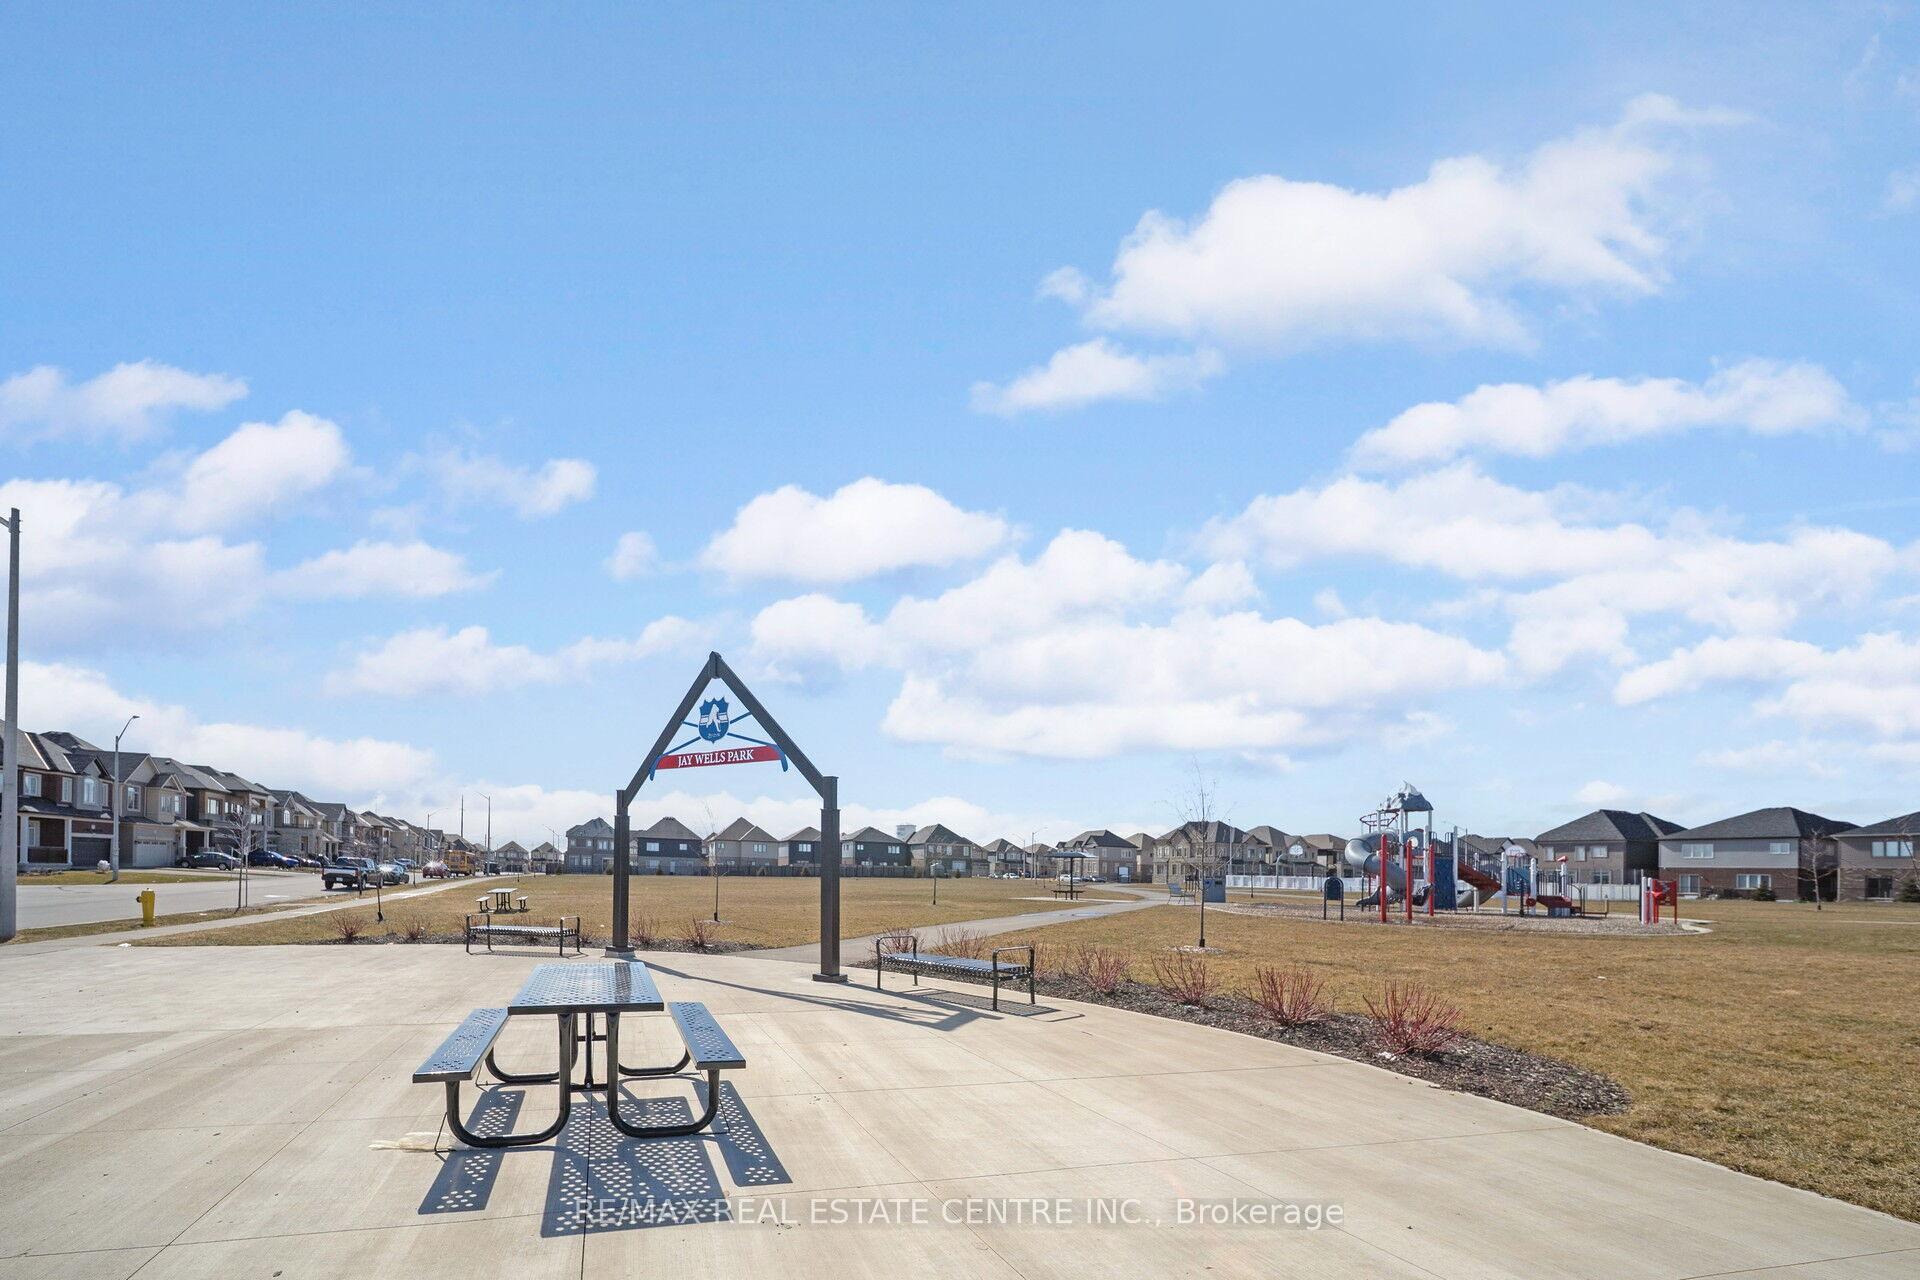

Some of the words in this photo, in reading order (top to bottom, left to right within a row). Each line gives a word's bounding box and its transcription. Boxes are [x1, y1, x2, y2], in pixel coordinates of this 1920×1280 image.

[678, 754, 693, 767] JAY
[694, 752, 726, 764] WELLS
[727, 749, 754, 762] PARK
